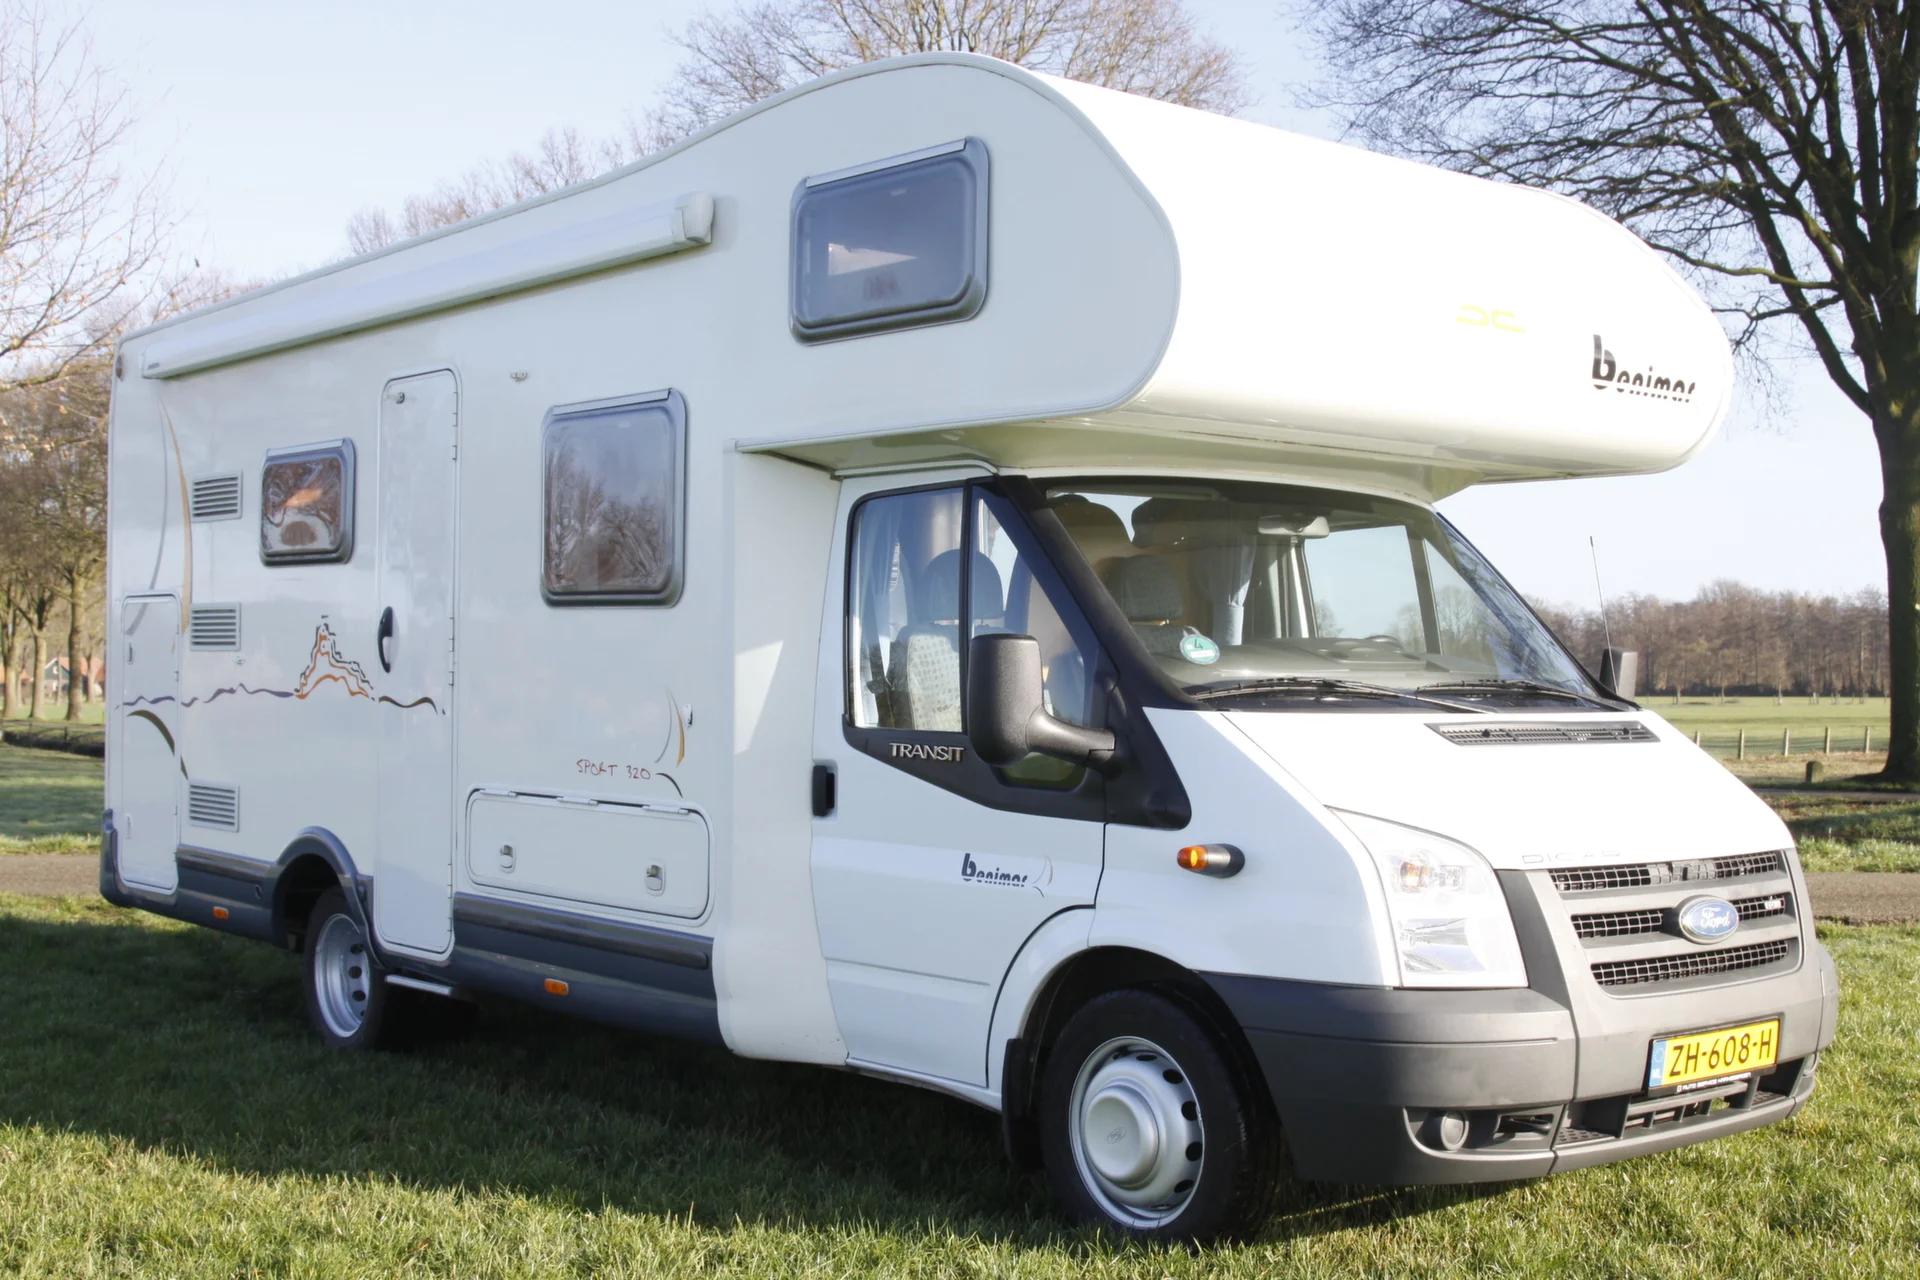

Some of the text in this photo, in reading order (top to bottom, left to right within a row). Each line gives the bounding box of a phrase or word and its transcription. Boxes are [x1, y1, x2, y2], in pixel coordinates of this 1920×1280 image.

[889, 743, 964, 762] TRANSIT
[576, 759, 651, 780] SPORT 320
[1700, 907, 1731, 929] Ford
[1669, 1028, 1772, 1077] ZH-608-H
